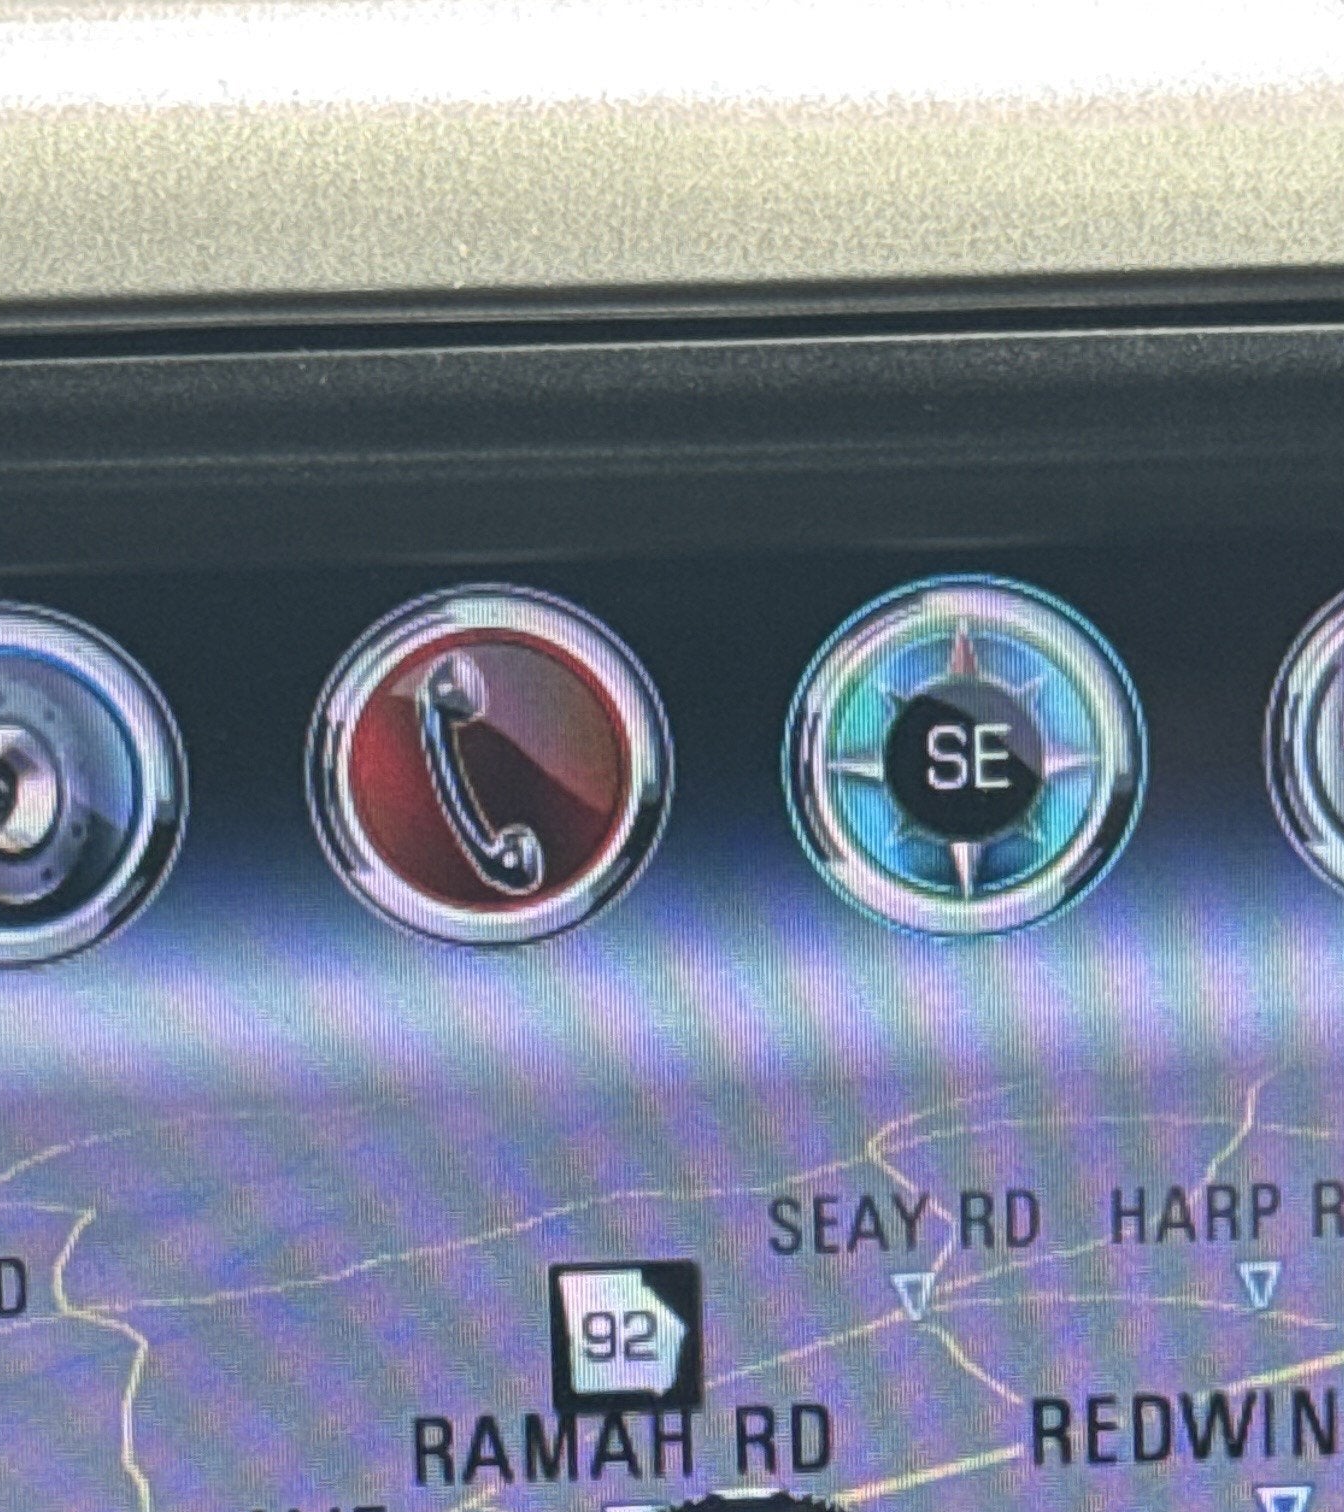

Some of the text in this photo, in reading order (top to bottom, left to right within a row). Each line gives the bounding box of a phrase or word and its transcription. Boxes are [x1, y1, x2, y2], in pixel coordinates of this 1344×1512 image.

[926, 722, 1013, 791] SE
[768, 1188, 1041, 1256] SEAY RD
[1110, 1183, 1280, 1244] HARP
[581, 1310, 659, 1363] 92
[414, 1403, 833, 1487] RAMAH RD
